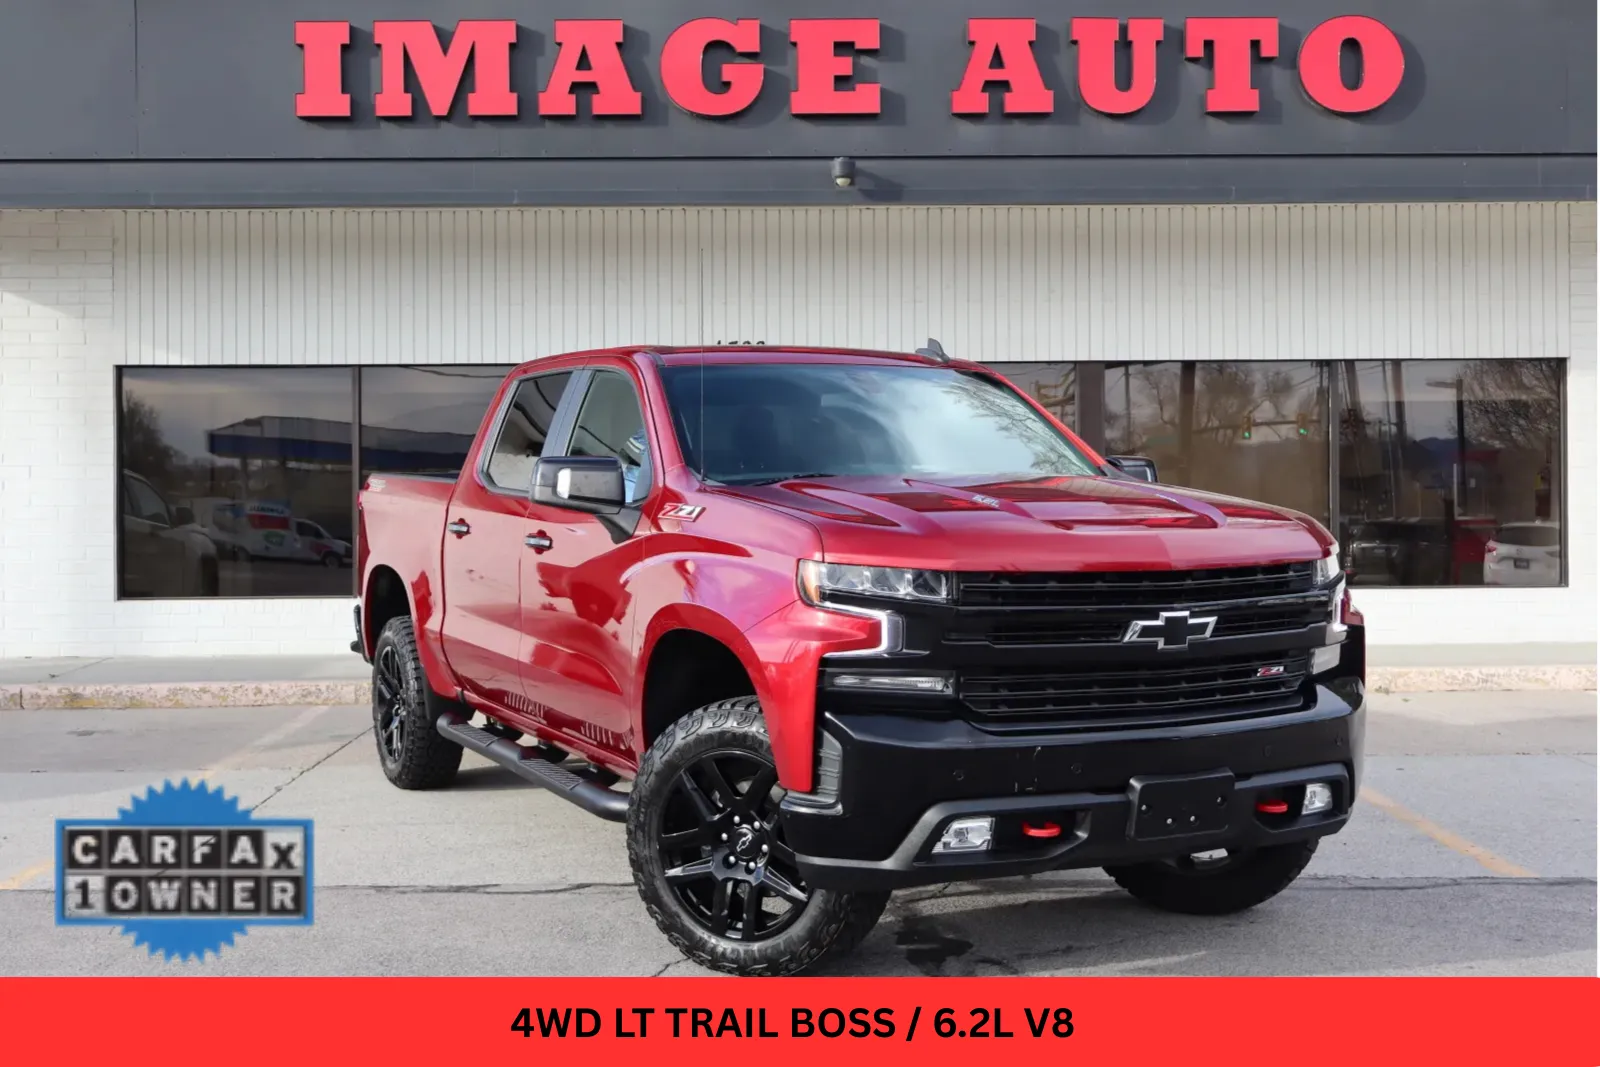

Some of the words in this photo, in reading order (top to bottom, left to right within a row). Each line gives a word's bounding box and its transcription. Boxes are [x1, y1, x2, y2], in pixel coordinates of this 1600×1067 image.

[295, 18, 881, 116] IMAGE
[952, 16, 1404, 114] AUTO
[658, 503, 703, 521] Z71
